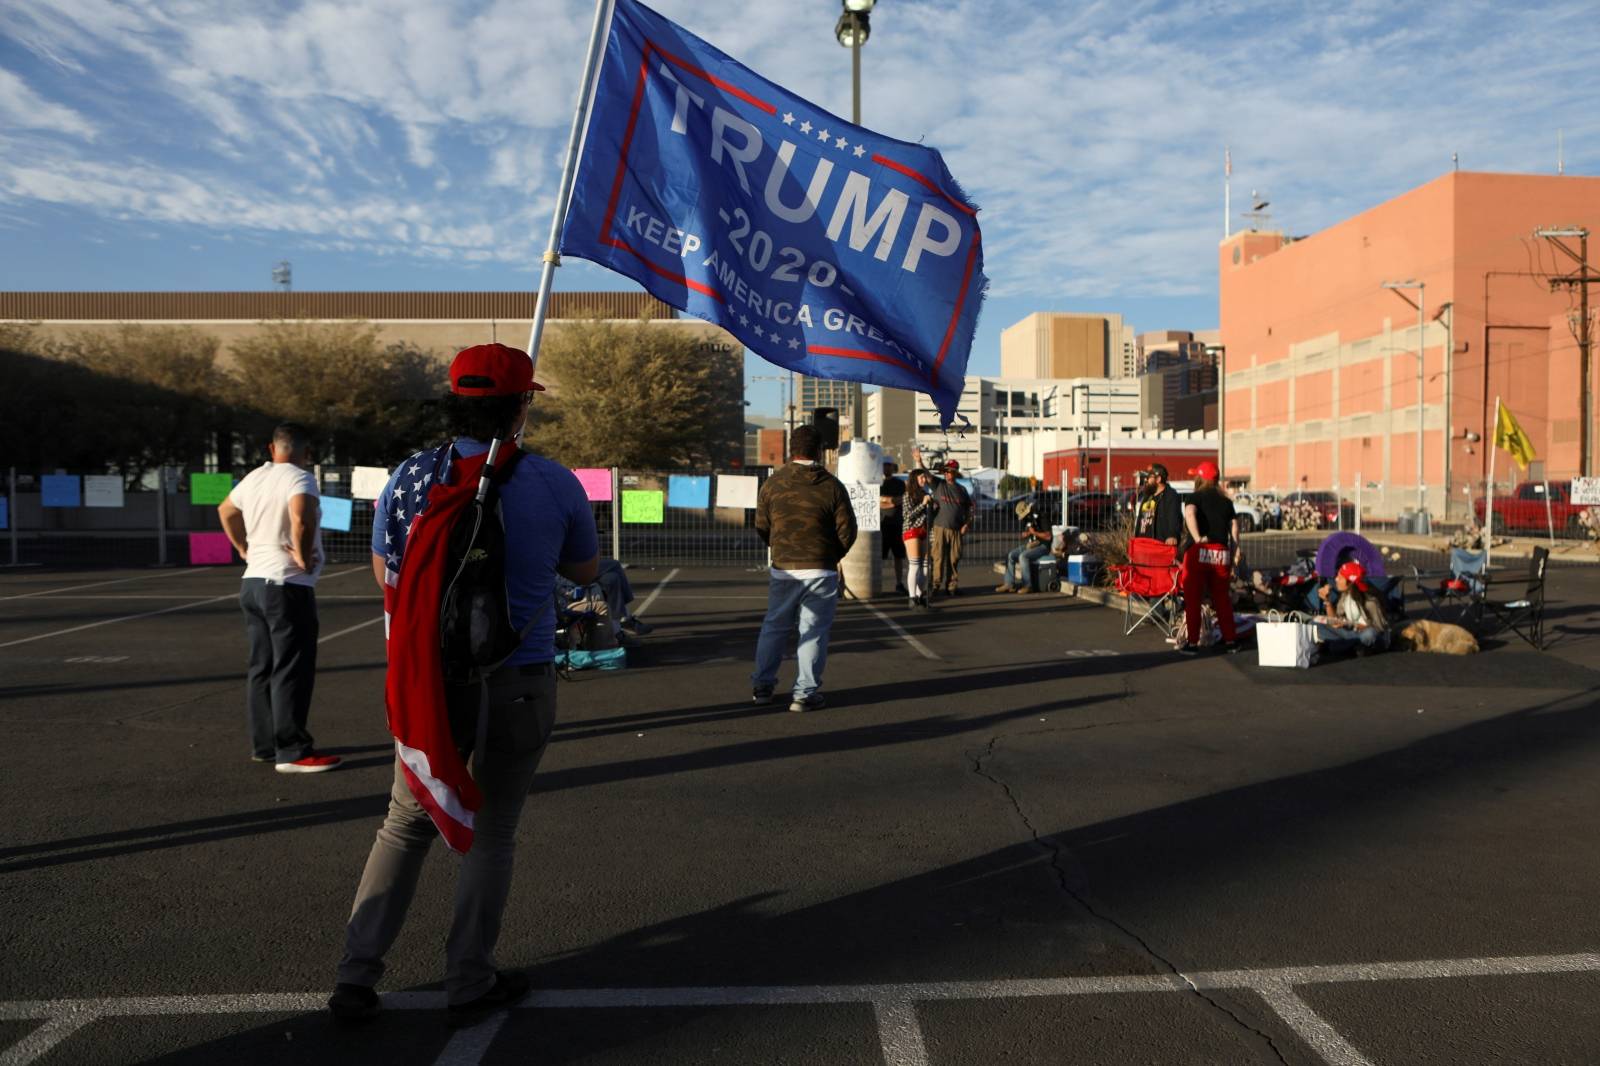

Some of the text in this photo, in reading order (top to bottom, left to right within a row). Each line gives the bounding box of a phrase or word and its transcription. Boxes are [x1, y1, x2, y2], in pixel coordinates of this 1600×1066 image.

[659, 63, 962, 272] TRUMP
[626, 206, 700, 257] KEEP
[702, 250, 813, 328] AMERICA
